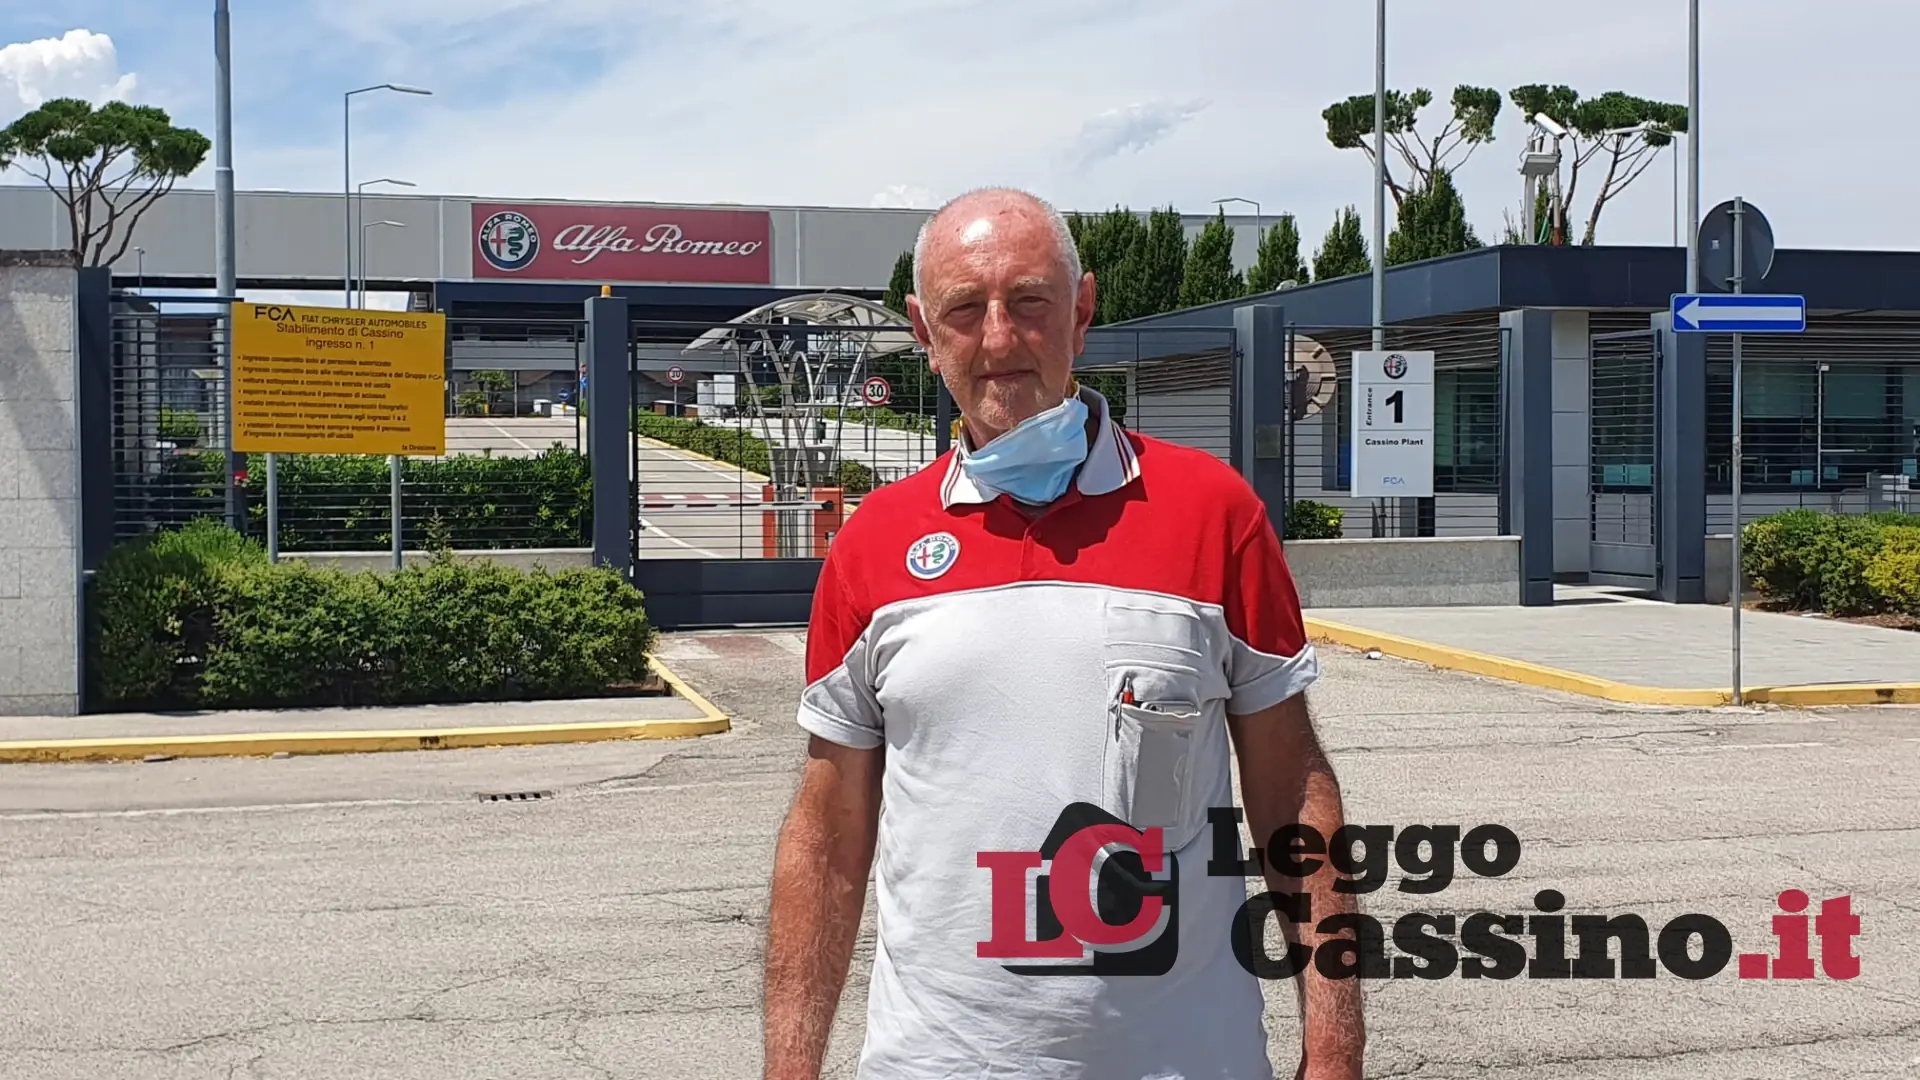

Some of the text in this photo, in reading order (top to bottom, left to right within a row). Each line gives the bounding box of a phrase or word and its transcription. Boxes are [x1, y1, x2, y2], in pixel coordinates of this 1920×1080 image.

[482, 214, 537, 242] ALFA ROMEO
[553, 223, 762, 264] Alfa Romeo
[255, 306, 427, 329] FCA FIAT CHRYSLER AUTOMOBILES
[277, 322, 404, 339] Stabilimento di Cassino
[356, 342, 366, 350] n.
[370, 341, 374, 350] 1
[869, 386, 884, 397] 30
[1385, 390, 1404, 424] 1
[1365, 438, 1424, 446] Cassino Plant
[1383, 477, 1405, 485] FCA
